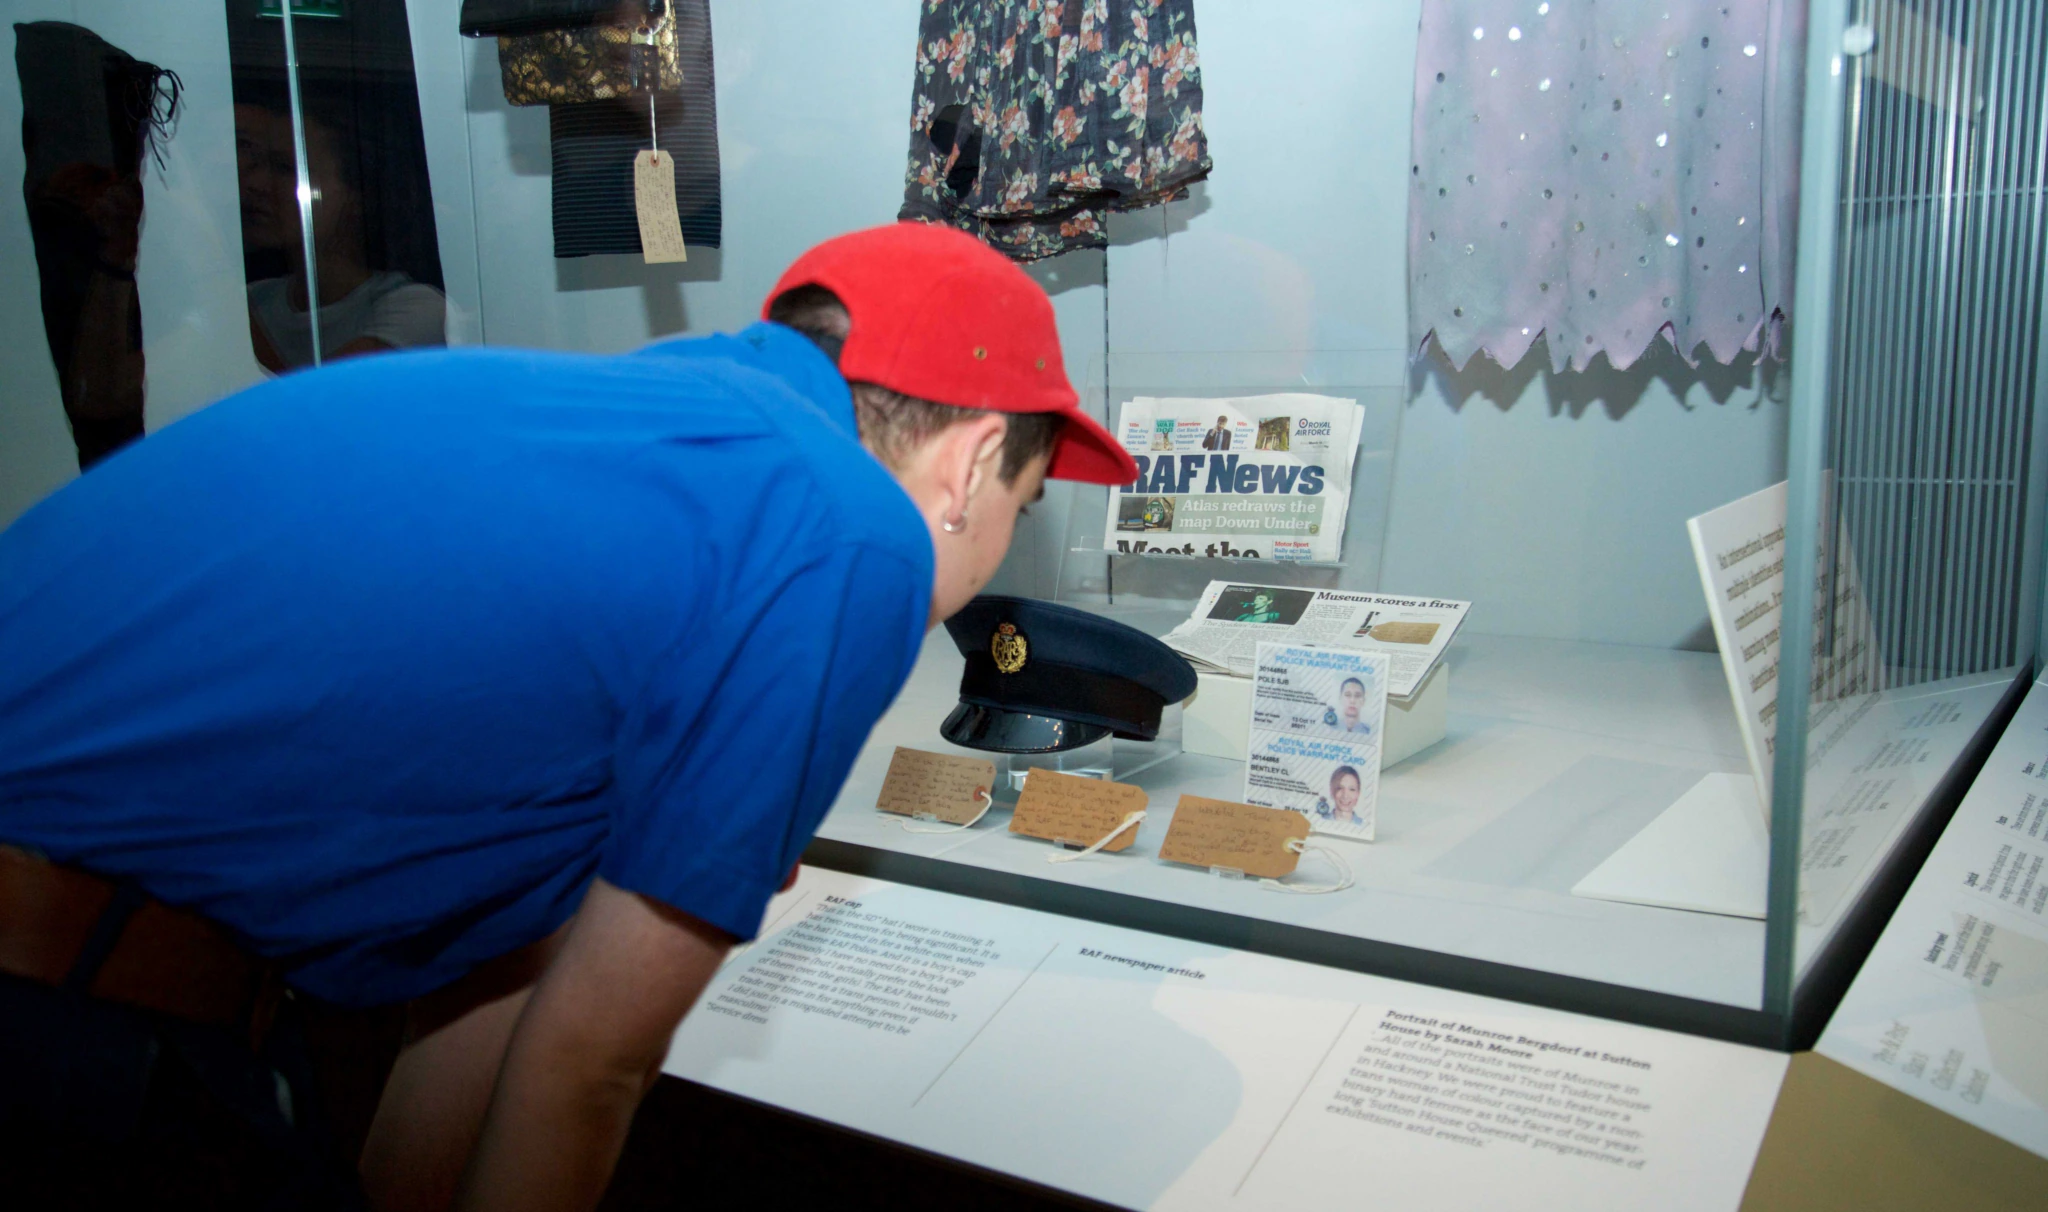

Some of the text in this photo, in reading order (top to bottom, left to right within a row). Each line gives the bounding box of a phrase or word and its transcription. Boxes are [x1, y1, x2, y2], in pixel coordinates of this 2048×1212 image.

[1119, 454, 1324, 495] RAF News
[1182, 499, 1317, 513] Atlas redraws the
[1179, 517, 1212, 530] map
[1215, 516, 1257, 529] Down
[1259, 517, 1311, 529] Under
[1316, 592, 1372, 604] Museum
[1374, 598, 1417, 607] scores
[1428, 600, 1460, 610] first
[1275, 655, 1374, 675] POLICE WARRANT CARD
[1286, 648, 1360, 663] ROYAL AIR FORCE
[1268, 744, 1366, 766] POLICE WARRANT CARD
[1279, 737, 1352, 755] ROYAL AIR FORCE
[1250, 764, 1280, 773] BENTLEY
[824, 895, 862, 910] RAF cap
[806, 912, 824, 921] has
[822, 915, 843, 925] two
[842, 921, 879, 933] reasons
[879, 928, 895, 936] for
[895, 931, 924, 945] being
[845, 910, 863, 918] the
[880, 917, 900, 926] hat
[902, 923, 929, 933] wore
[791, 930, 829, 944] became
[828, 939, 850, 948] RAF
[879, 950, 903, 960] And
[955, 969, 976, 979] cap
[796, 920, 814, 929] the
[813, 924, 831, 933] hat
[835, 929, 869, 941] traded
[867, 936, 879, 944] in
[878, 939, 894, 947] for
[901, 945, 932, 955] white
[954, 957, 985, 967] when
[1079, 948, 1206, 980] RAF newspaper article
[1378, 1021, 1533, 1059] House by Sarah Moore
[1385, 1010, 1439, 1026] Portrait
[1457, 1024, 1513, 1041] Munroe
[1516, 1036, 1580, 1055] Bergdorf
[1582, 1050, 1598, 1059] at
[1600, 1053, 1651, 1070] Sutton
[1363, 1045, 1391, 1055] and
[1391, 1051, 1442, 1066] around
[1454, 1063, 1516, 1083] National
[1519, 1077, 1556, 1091] Trust
[1560, 1085, 1602, 1101] Tudor
[1604, 1095, 1651, 1112] house
[1401, 1040, 1417, 1048] of
[1417, 1042, 1442, 1053] the
[1441, 1049, 1503, 1066] portraits
[1505, 1062, 1542, 1074] were
[1543, 1070, 1560, 1078] of
[1561, 1072, 1621, 1091] Munroe
[1623, 1085, 1639, 1095] in
[1348, 1066, 1384, 1081] trans
[1385, 1077, 1439, 1093] woman
[1440, 1089, 1457, 1097] of
[1457, 1093, 1503, 1108] colour
[1504, 1103, 1572, 1123] captured
[1573, 1116, 1594, 1131] by
[1356, 1055, 1371, 1064] in
[1436, 1072, 1459, 1084] We
[1460, 1079, 1497, 1092] were
[1497, 1088, 1544, 1103] proud
[1544, 1096, 1562, 1107] to
[1563, 1100, 1619, 1119] feature
[1325, 1105, 1403, 1128] exhibitions
[1405, 1124, 1434, 1135] and
[1340, 1078, 1386, 1098] binary
[1387, 1089, 1422, 1103] hard
[1421, 1096, 1474, 1115] femme
[1475, 1111, 1492, 1120] as
[1493, 1113, 1520, 1126] the
[1521, 1119, 1553, 1134] face
[1554, 1128, 1572, 1138] of
[1573, 1133, 1601, 1145] our
[1332, 1090, 1365, 1107] long
[1417, 1110, 1464, 1128] House
[1531, 1138, 1624, 1165] programme
[1626, 1160, 1644, 1170] of
